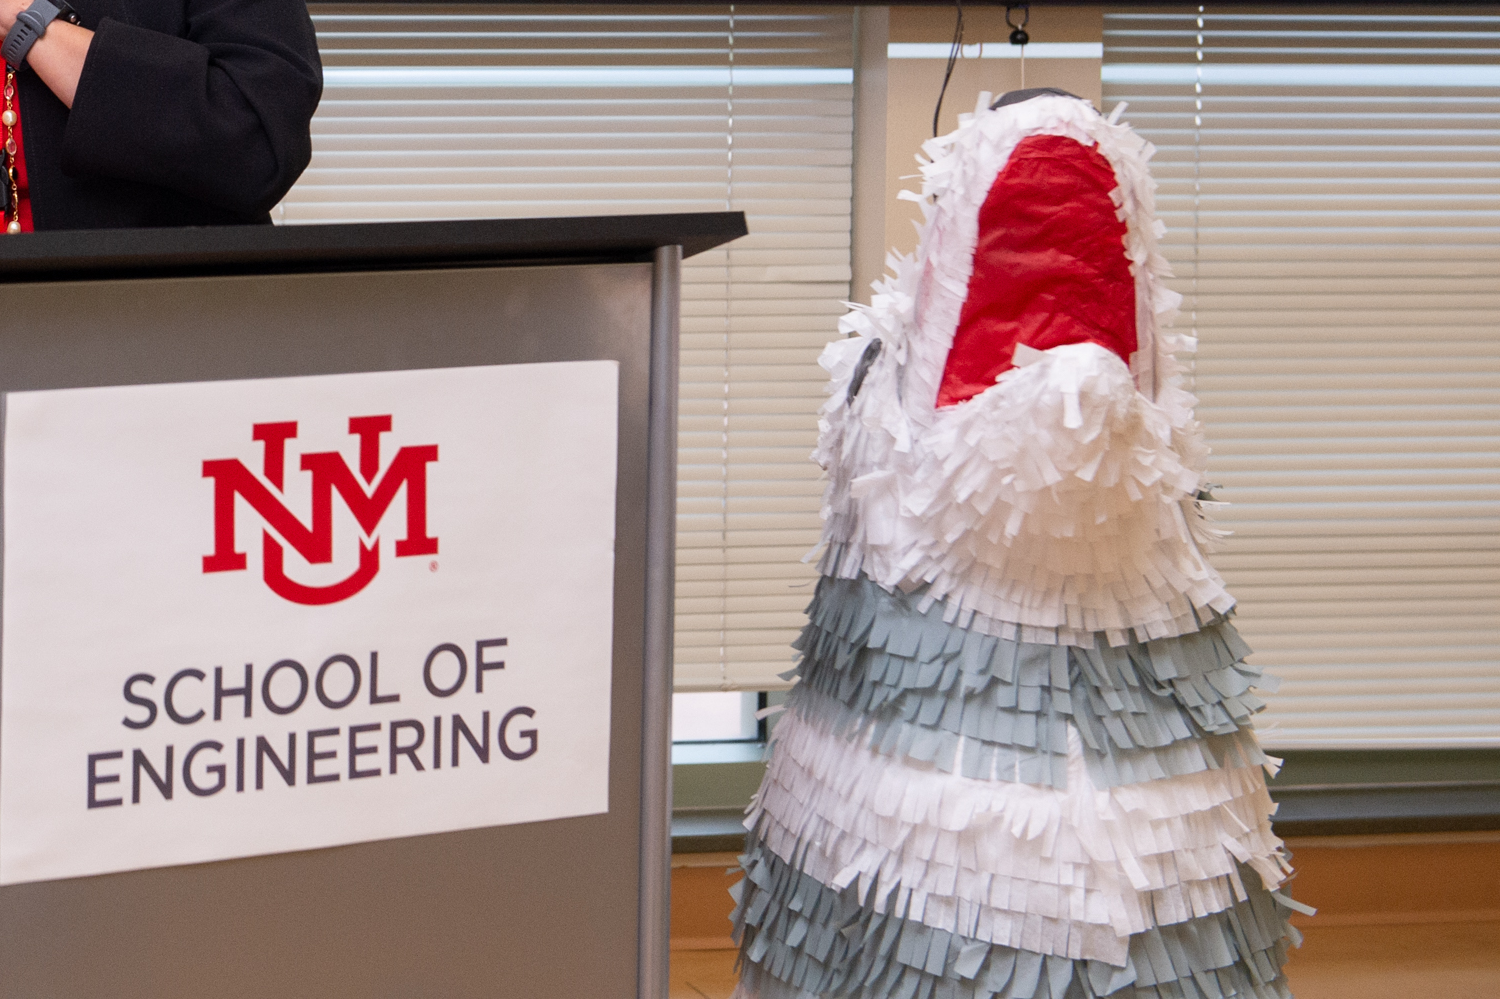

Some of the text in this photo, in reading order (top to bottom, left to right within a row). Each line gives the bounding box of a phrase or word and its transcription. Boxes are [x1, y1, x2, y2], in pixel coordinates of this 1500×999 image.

[121, 637, 508, 730] SCHOOL OF
[86, 706, 539, 810] ENGINEERING
